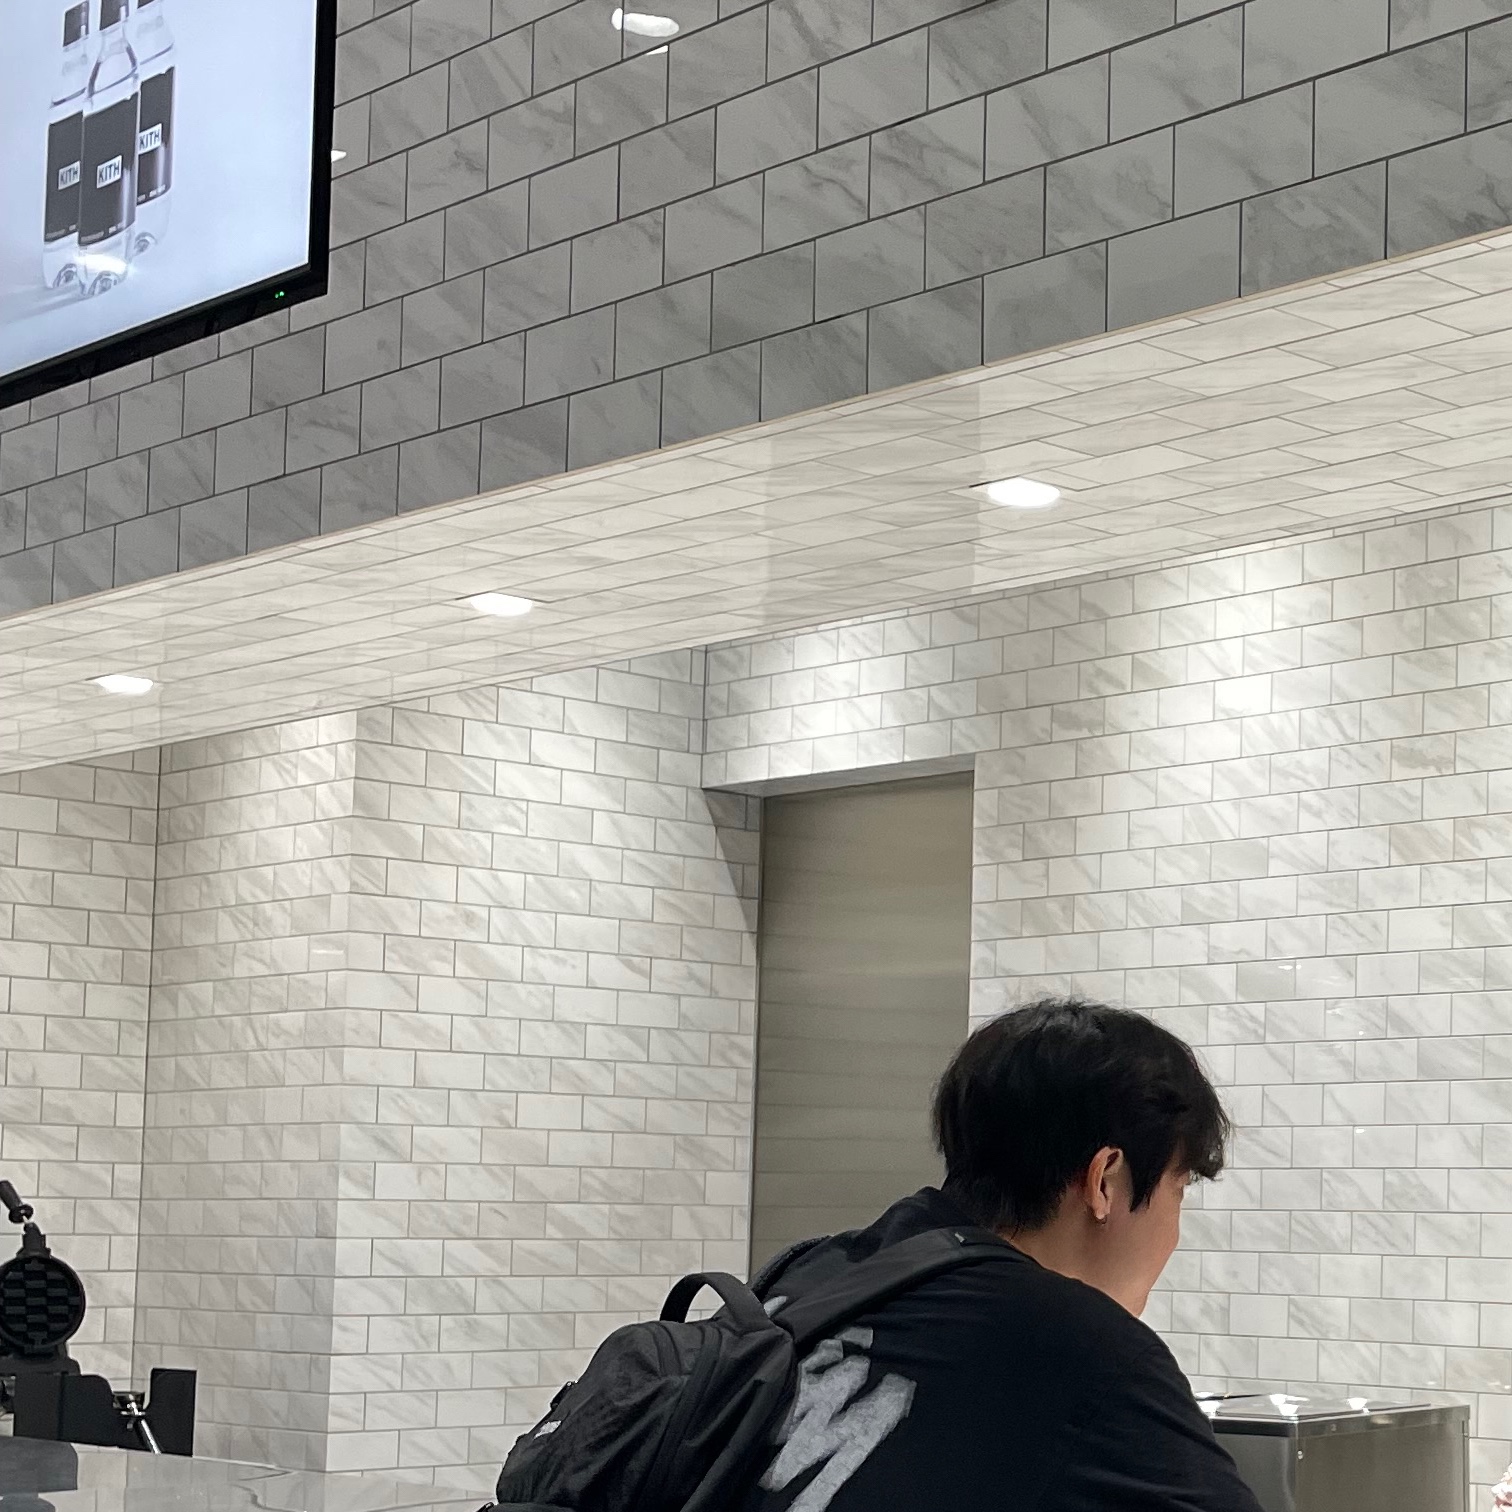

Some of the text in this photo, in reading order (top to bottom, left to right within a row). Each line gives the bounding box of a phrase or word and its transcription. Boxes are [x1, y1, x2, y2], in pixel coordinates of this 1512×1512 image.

[139, 130, 160, 150] KITH
[60, 167, 78, 184] KITH
[98, 161, 120, 182] KITH
